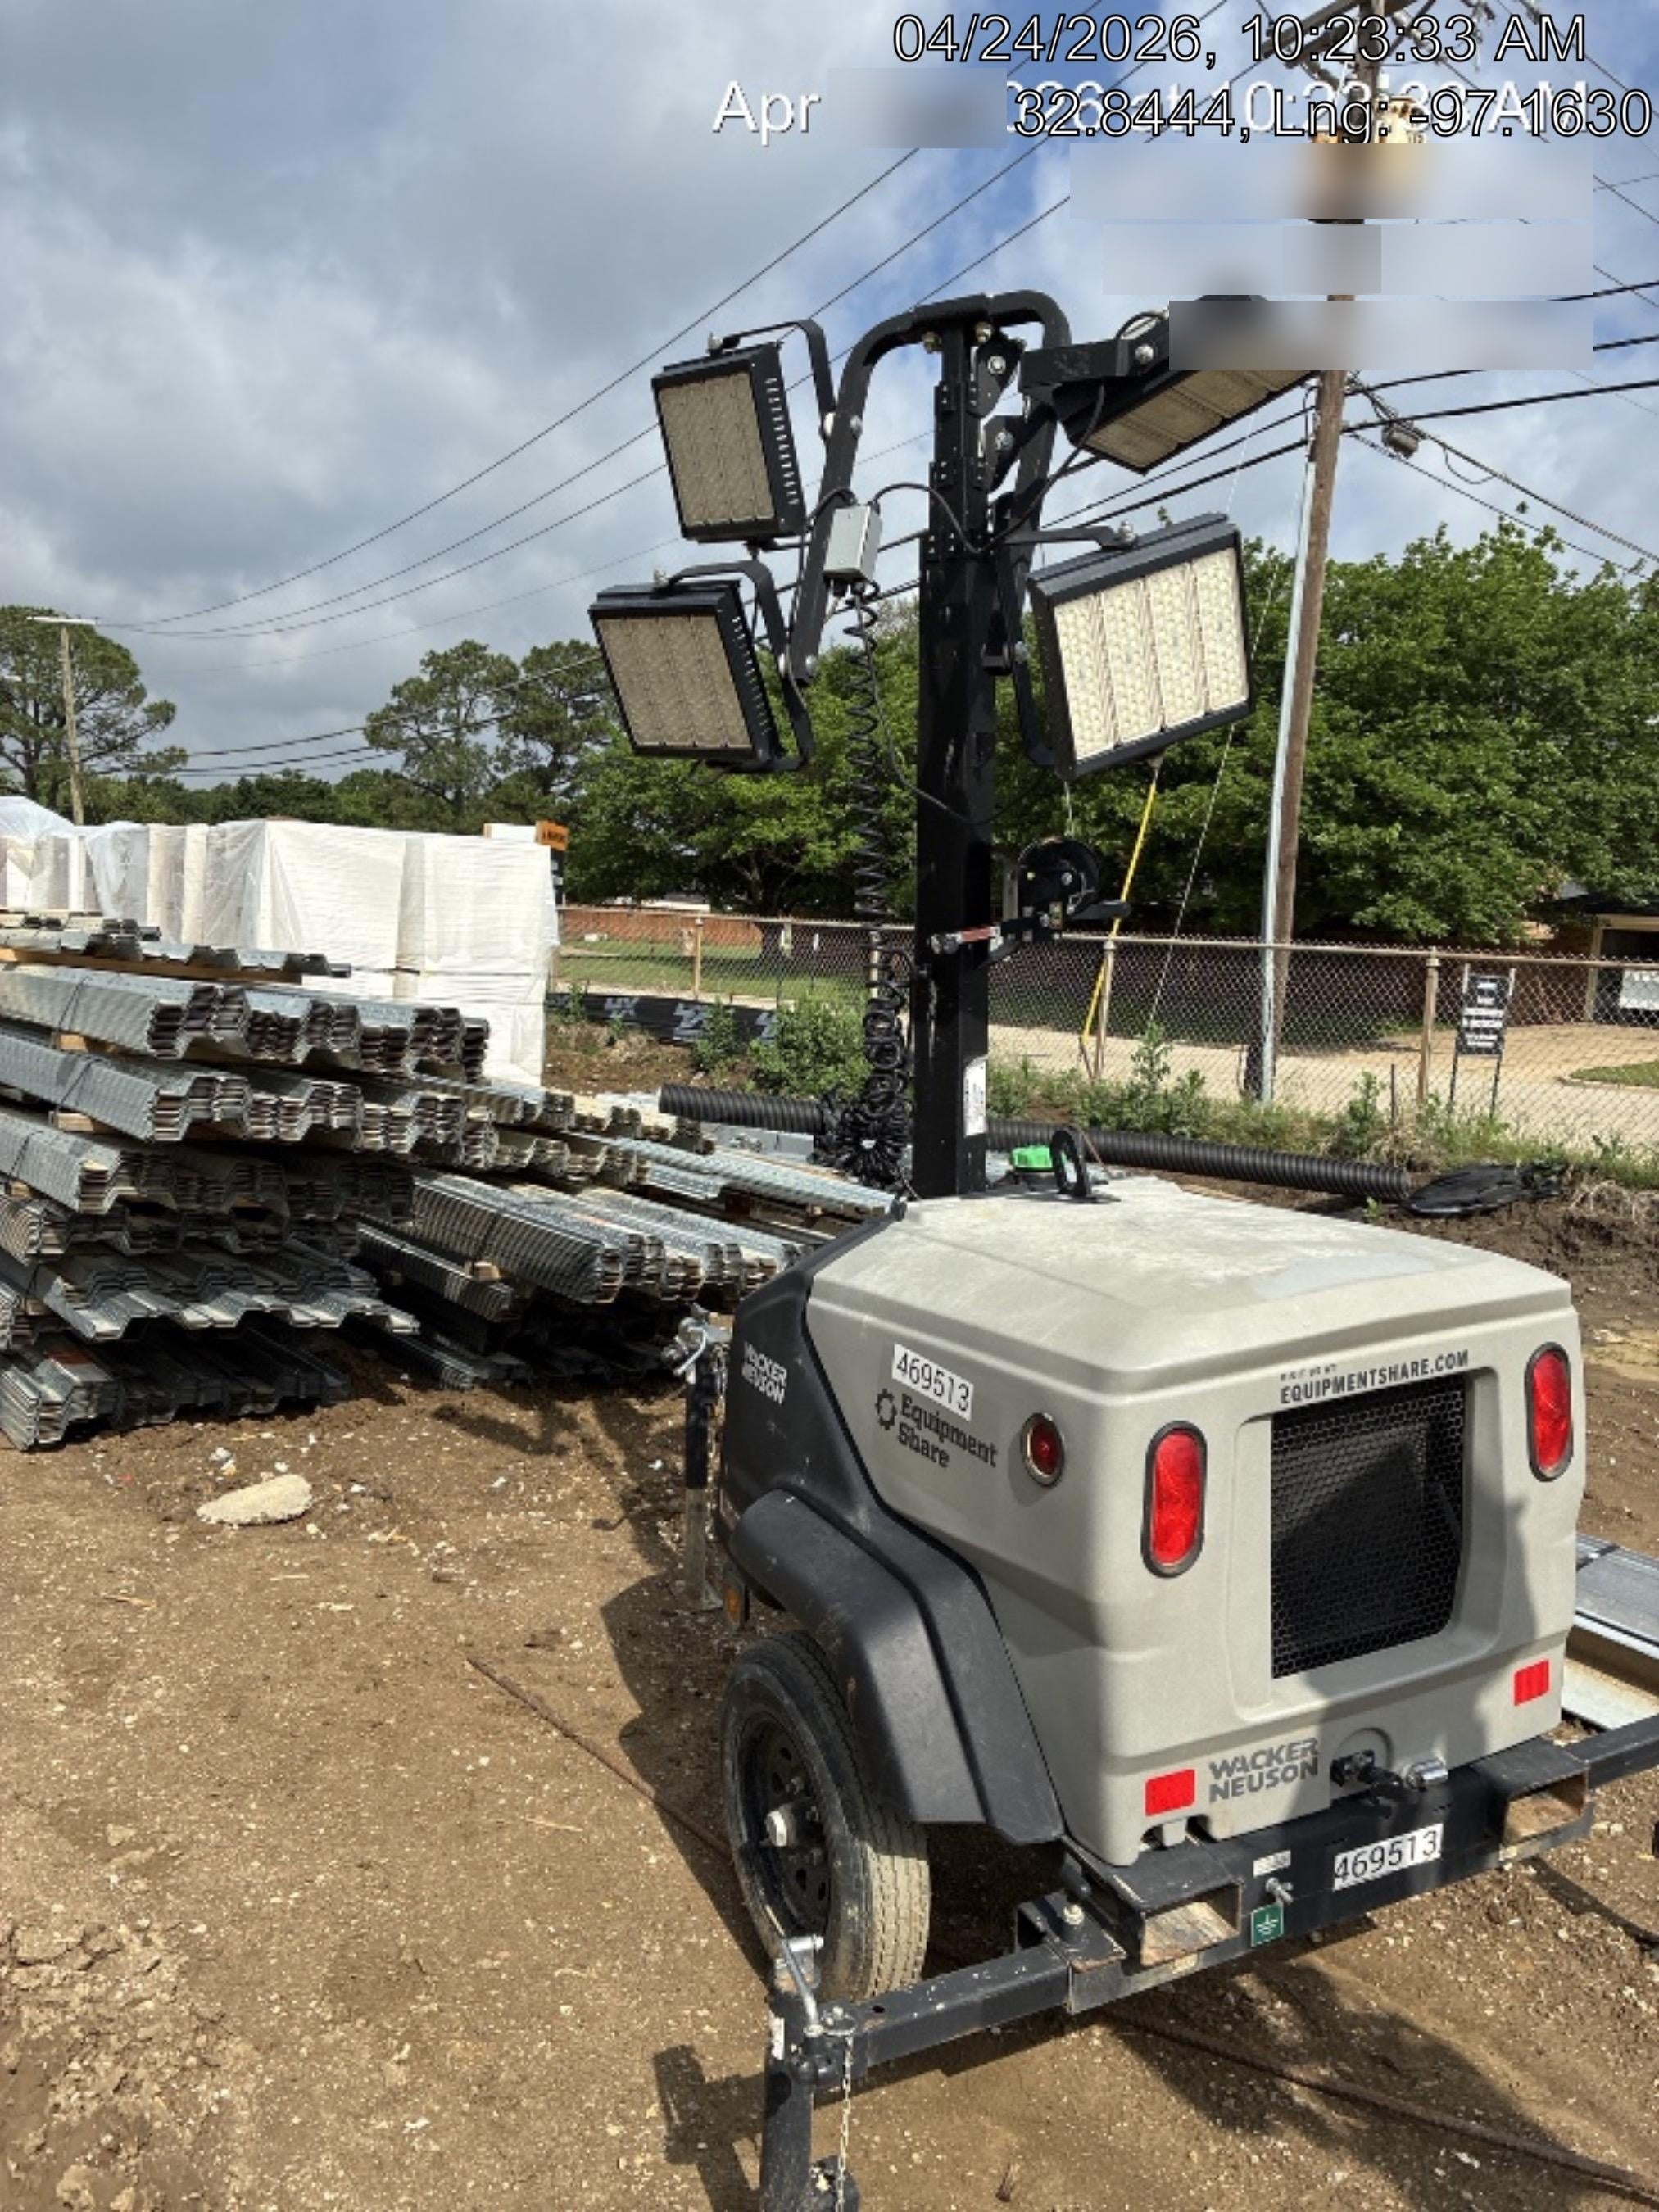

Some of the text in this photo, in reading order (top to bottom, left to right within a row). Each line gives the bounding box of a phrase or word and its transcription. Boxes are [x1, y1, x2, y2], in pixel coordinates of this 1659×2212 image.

[896, 1353, 970, 1412] 469513
[1280, 1349, 1469, 1404] EQUIPMENTSHARE.COM
[897, 1422, 950, 1468] Share
[901, 1393, 999, 1468] Equipment
[1208, 1737, 1319, 1780] WACKER
[1208, 1756, 1318, 1803] NEUSON
[1335, 1829, 1437, 1882] 469513
